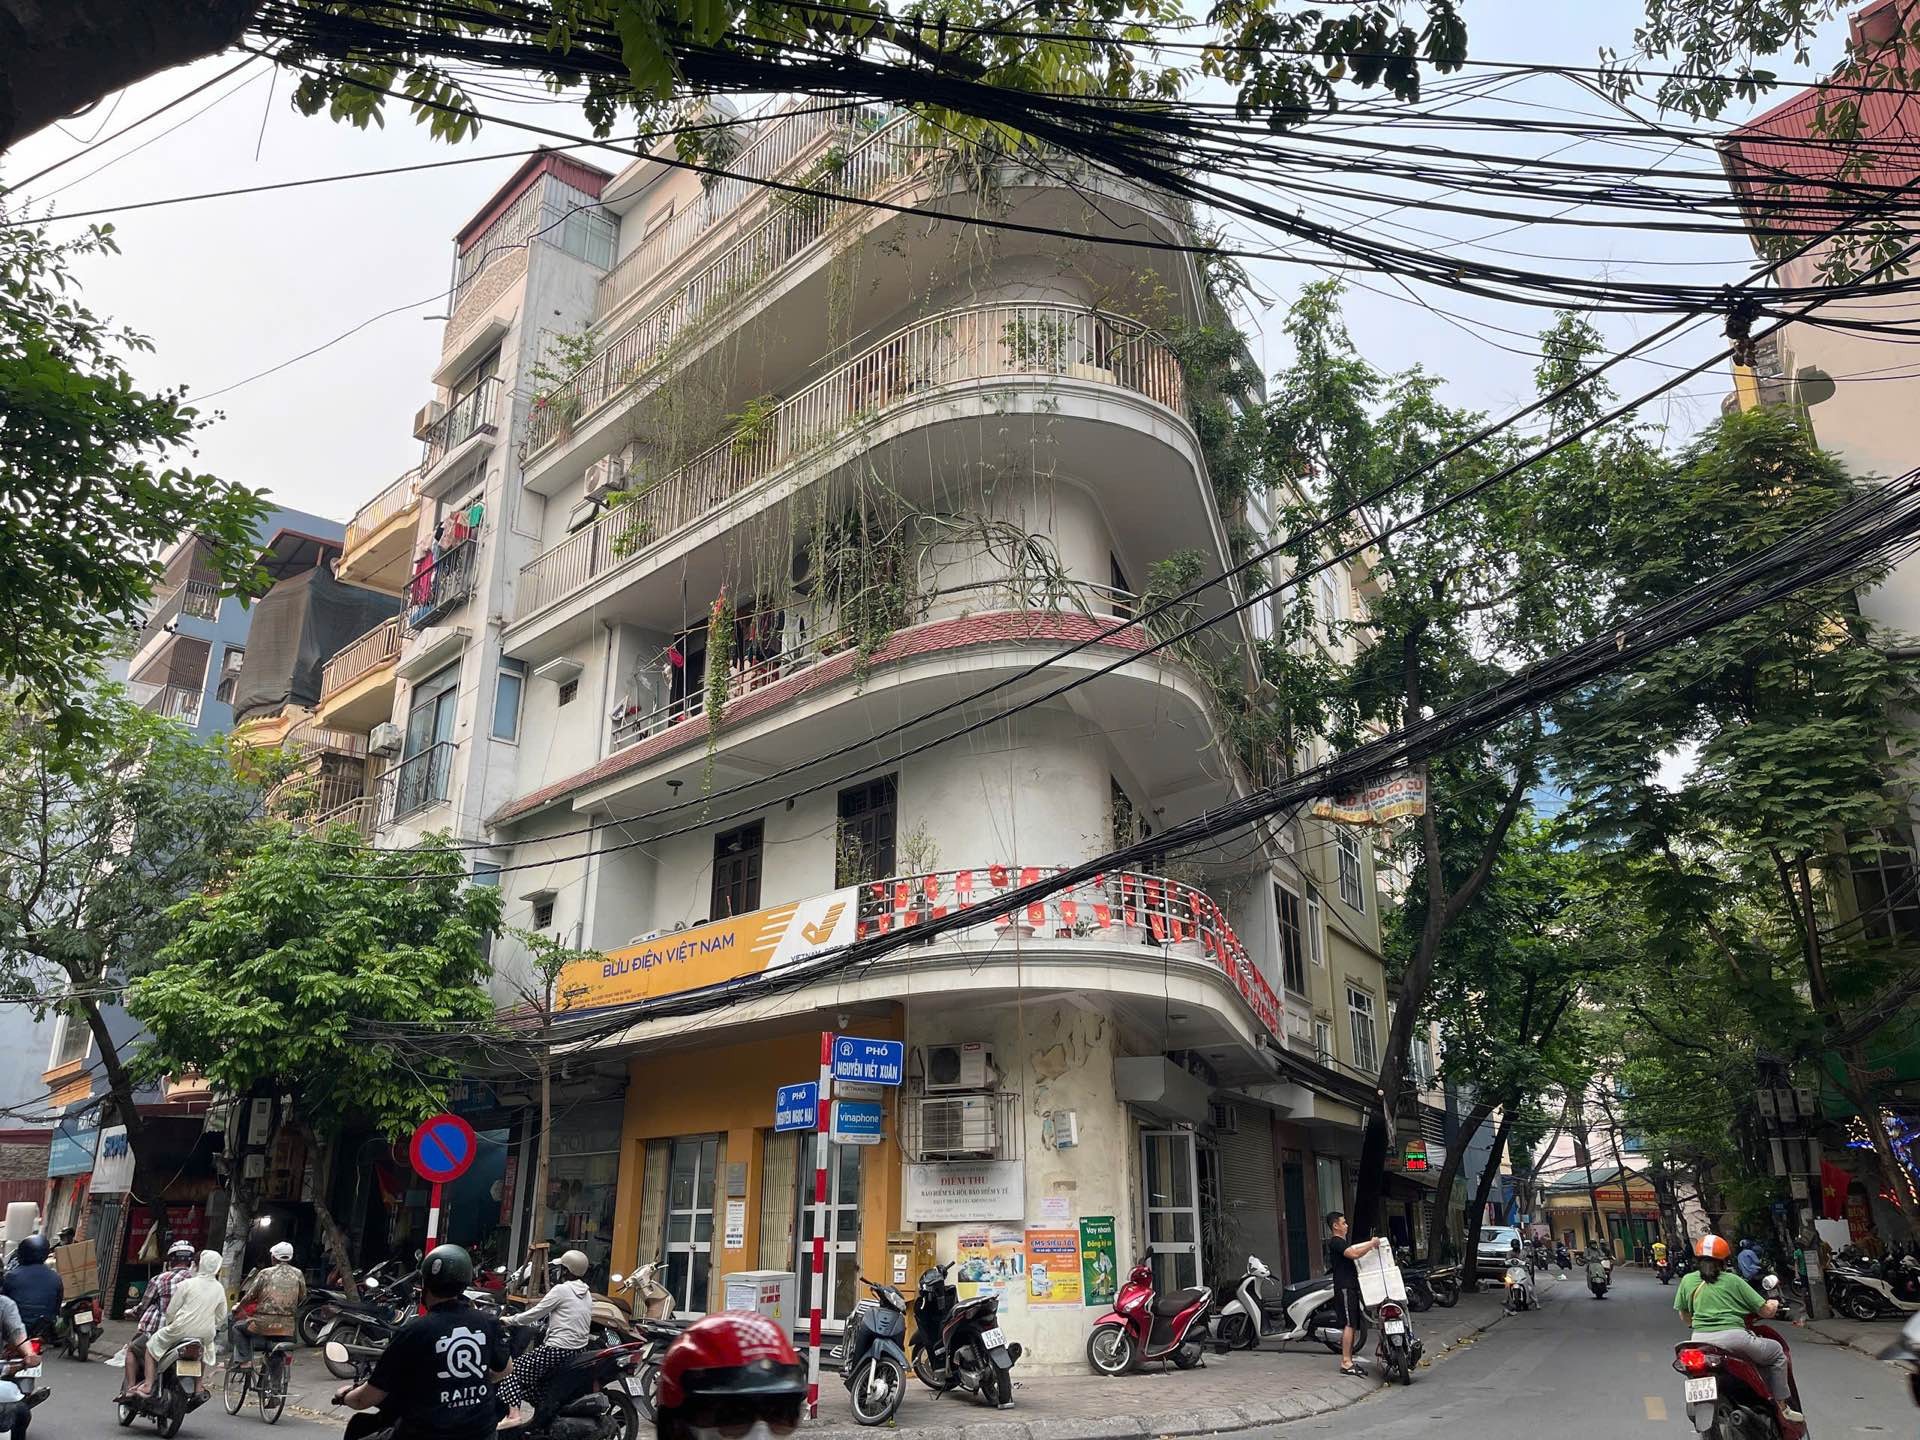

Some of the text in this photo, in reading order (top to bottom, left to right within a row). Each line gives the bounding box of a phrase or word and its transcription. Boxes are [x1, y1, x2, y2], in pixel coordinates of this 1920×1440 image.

[602, 932, 735, 978] BƯU ĐIỆN VIỆT NAM
[865, 1044, 888, 1056] PHỐ
[837, 1058, 898, 1080] NGUYỄN VIẾT XUÂN
[792, 1087, 807, 1100] PHỐ
[840, 1111, 879, 1124] vinaphone
[441, 1384, 488, 1403] RAITO
[447, 1399, 481, 1408] CAMERA
